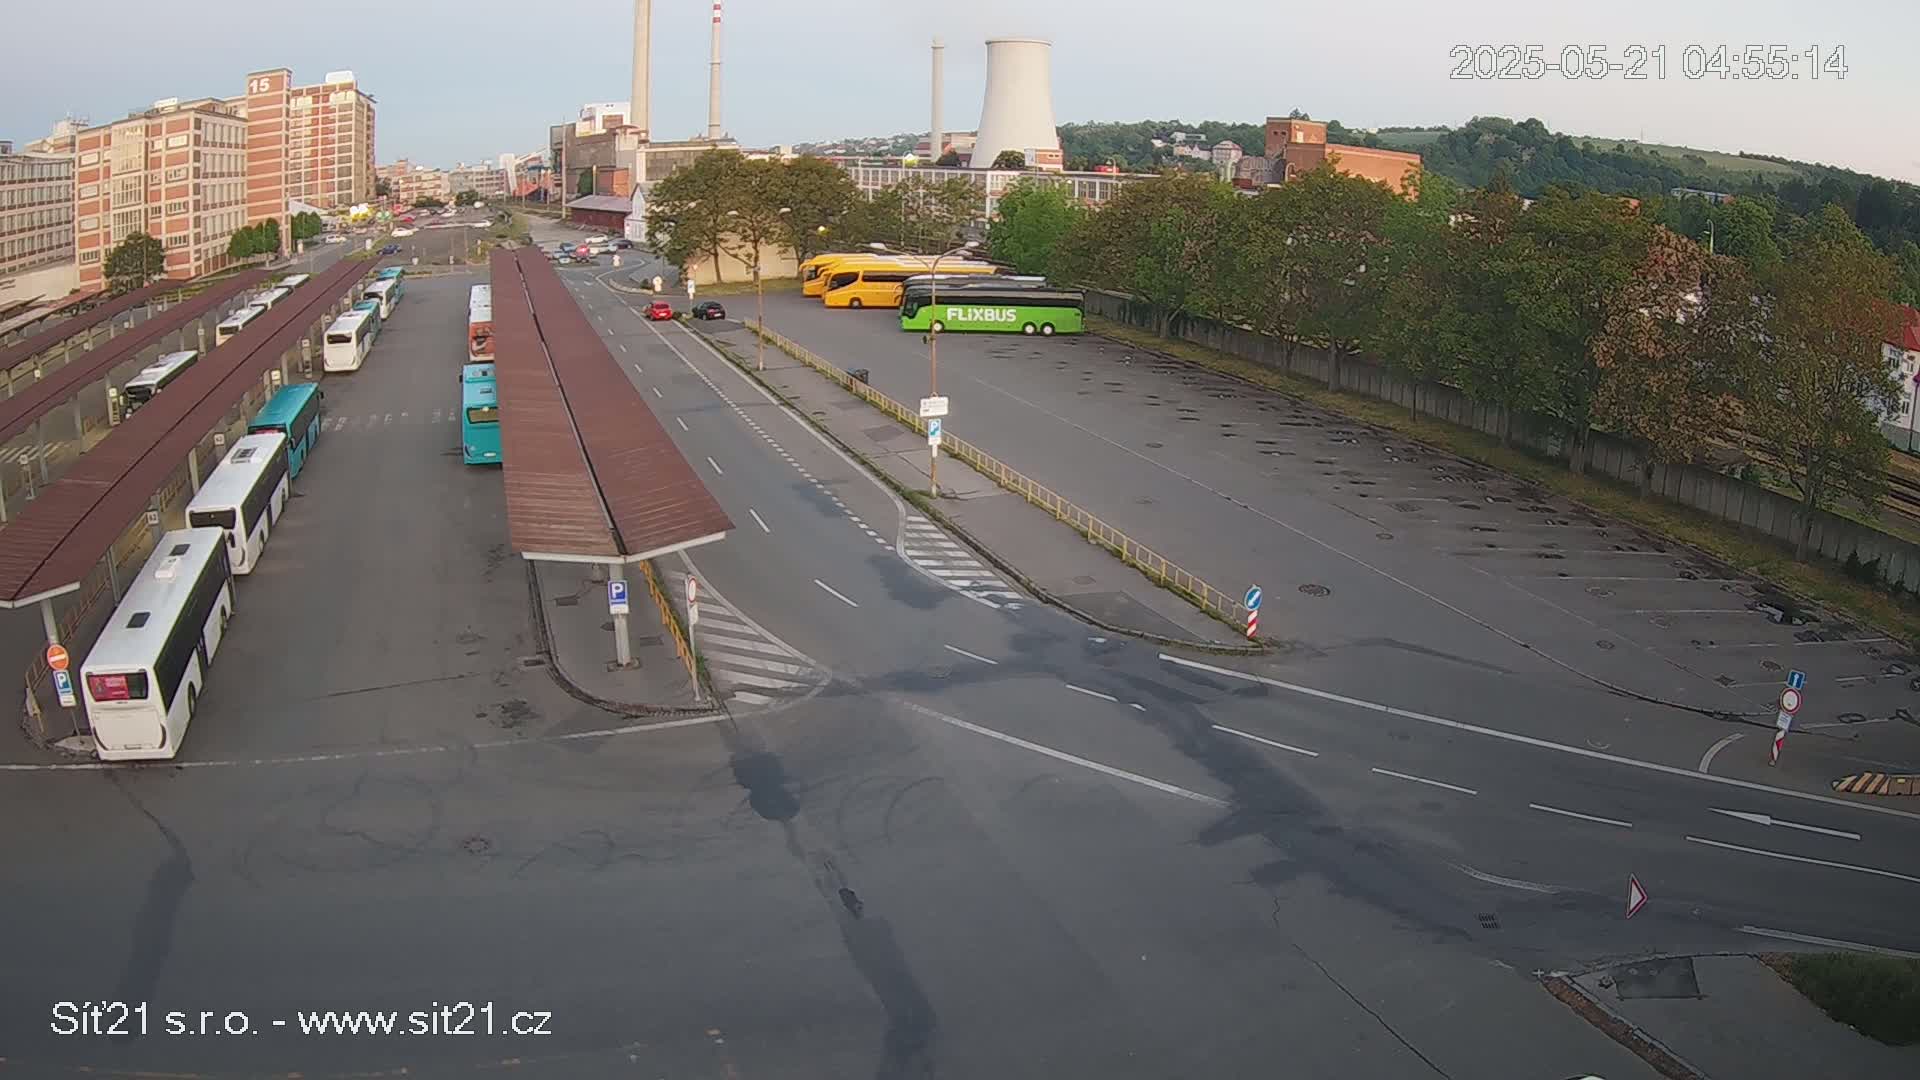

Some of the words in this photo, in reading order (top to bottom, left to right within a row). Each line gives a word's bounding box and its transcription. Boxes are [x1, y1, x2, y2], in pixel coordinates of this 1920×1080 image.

[249, 77, 270, 94] 15
[611, 582, 624, 599] P
[56, 673, 68, 689] P
